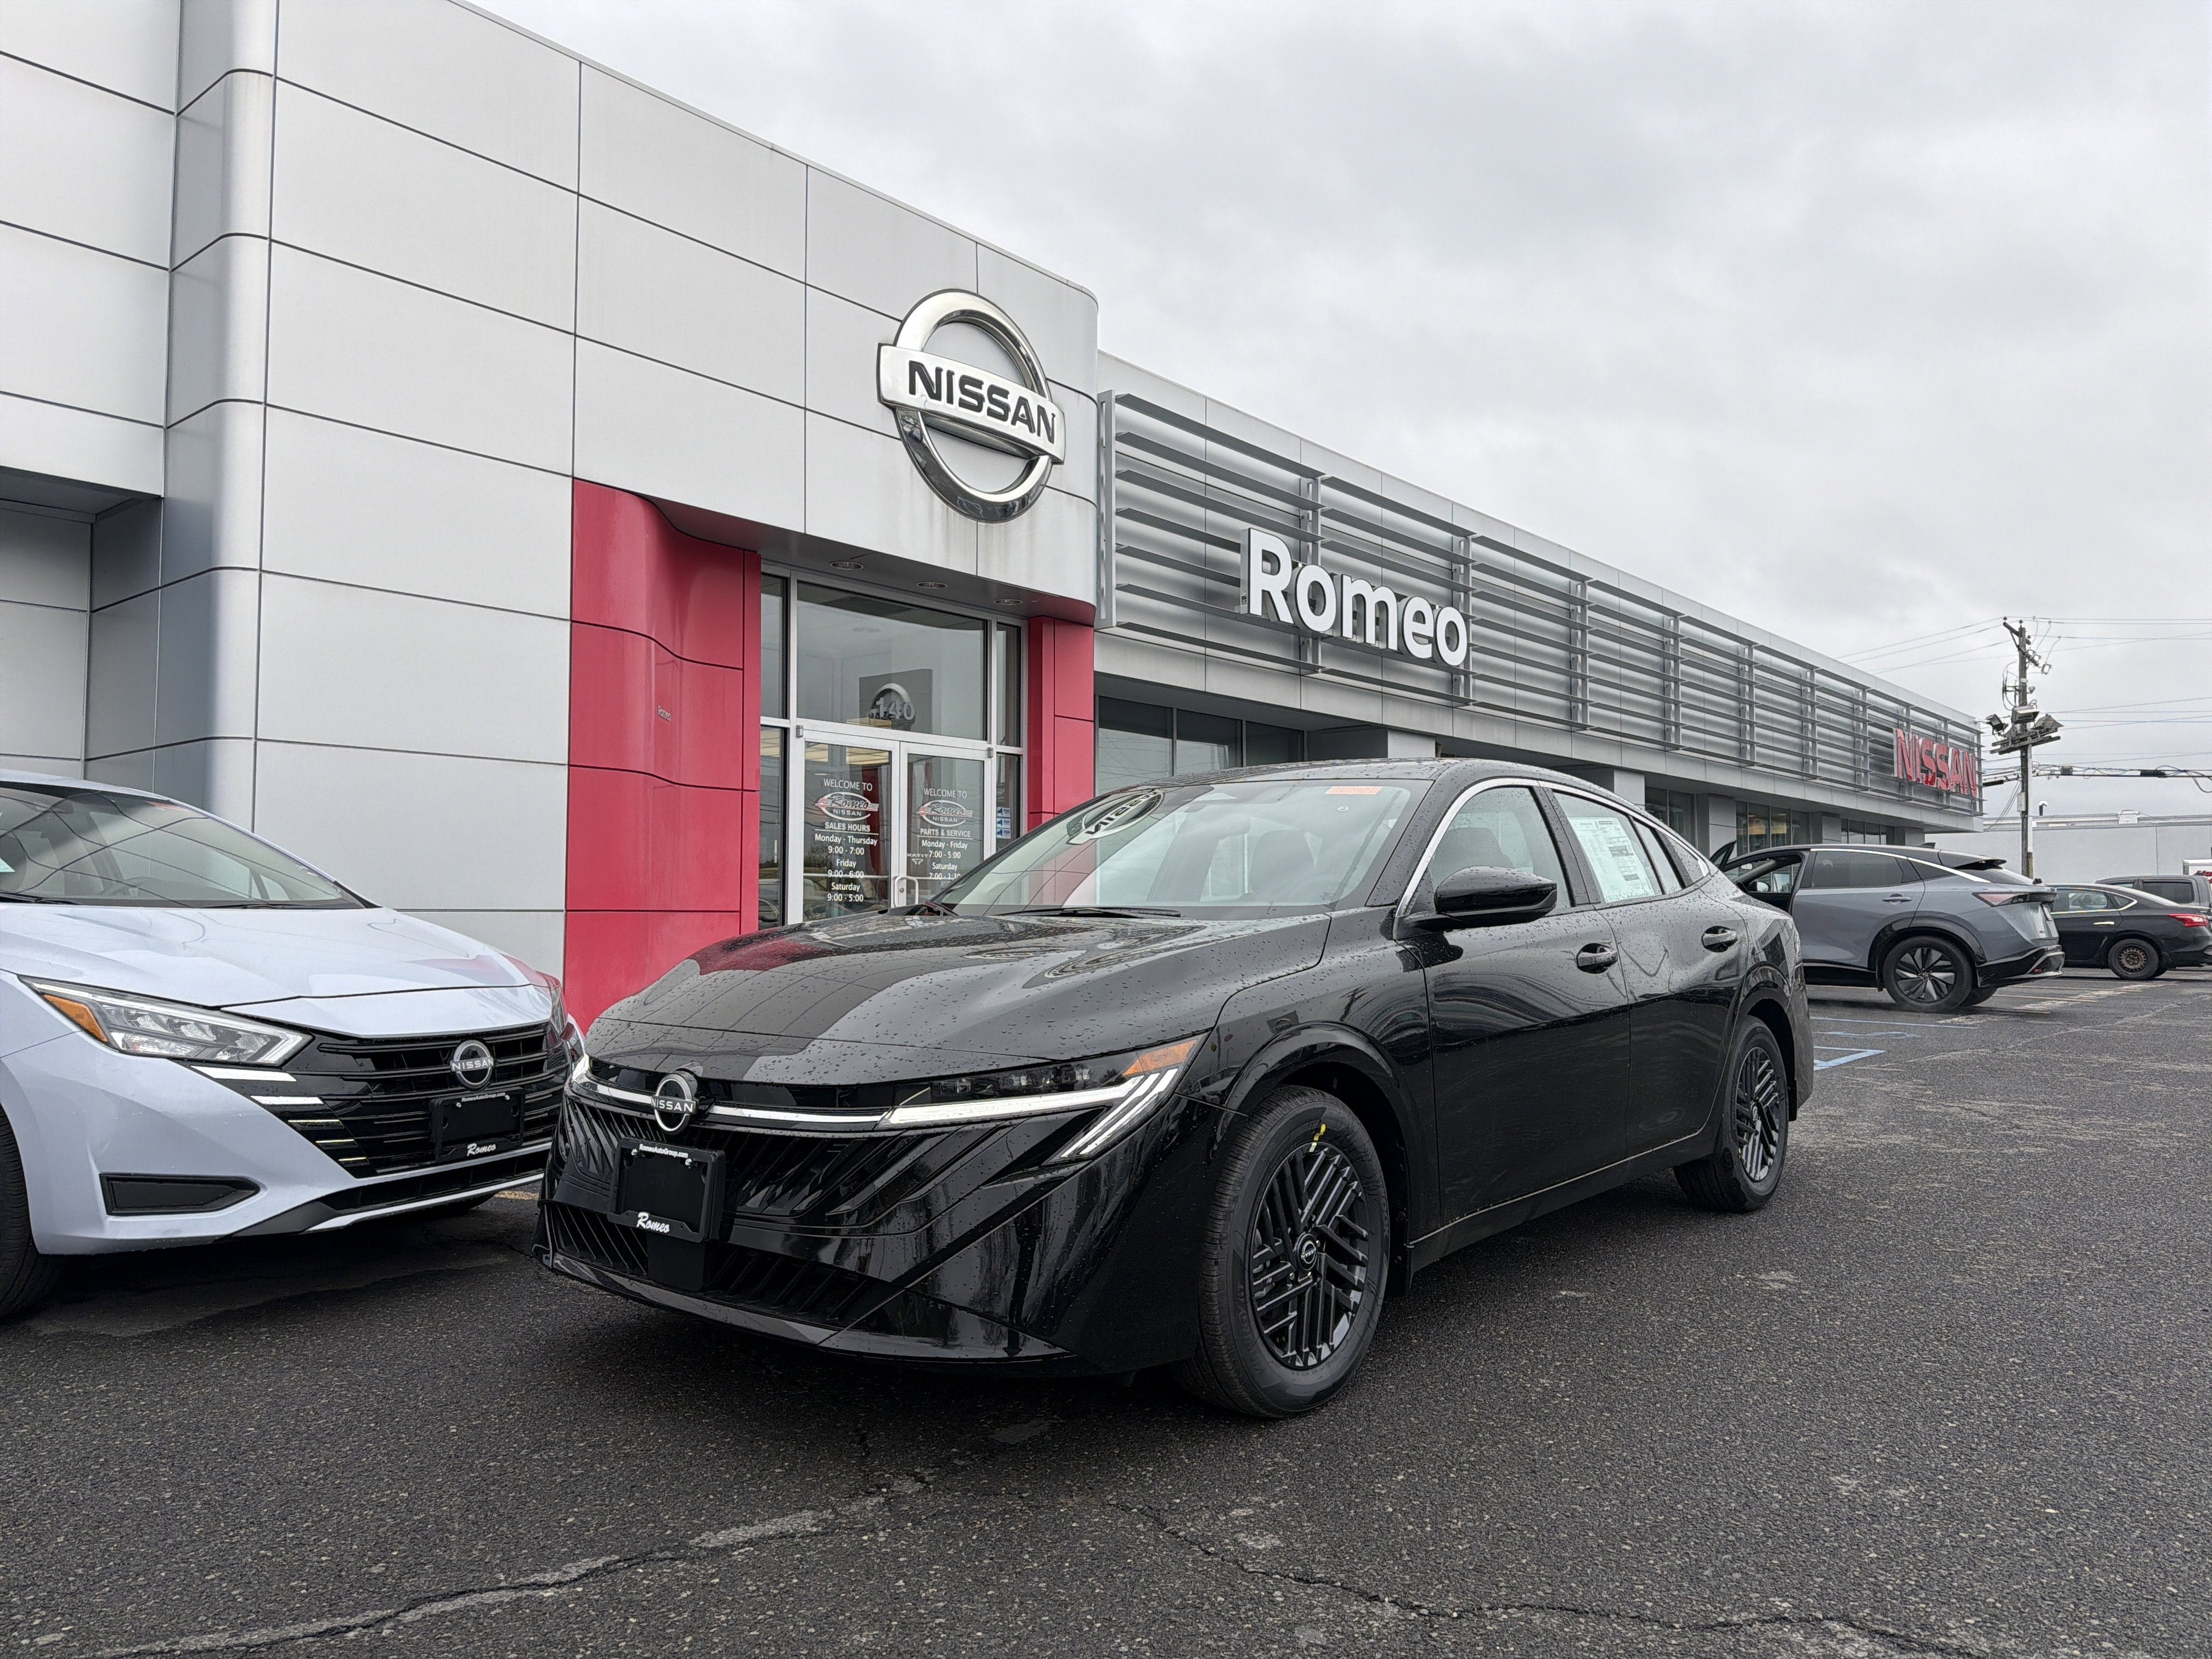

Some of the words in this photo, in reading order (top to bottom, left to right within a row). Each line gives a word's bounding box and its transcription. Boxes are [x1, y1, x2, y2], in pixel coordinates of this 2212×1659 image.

[909, 360, 1056, 445] NISSAN
[1248, 527, 1468, 667] Romeo
[876, 697, 915, 720] 140
[1896, 729, 1977, 798] NISSAN
[823, 778, 860, 790] WELCOME
[862, 782, 873, 791] TO
[923, 788, 956, 798] WELCOME
[957, 791, 967, 799] TO
[827, 793, 870, 809] Romeo
[927, 801, 964, 816] Romeo
[825, 821, 846, 830] SALES
[848, 823, 871, 832] HOURS
[920, 828, 939, 836] PARTS
[815, 833, 842, 844] Monday
[847, 835, 878, 847] Thursday
[922, 839, 945, 849] Monday
[950, 840, 968, 850] Friday
[828, 845, 843, 854] 9:00
[849, 847, 865, 855] 7:00
[929, 850, 943, 858] 7:00
[947, 851, 961, 859] 5:00
[836, 859, 856, 868] Friday
[932, 862, 958, 872] Saturday
[828, 870, 843, 878] 9:00
[849, 871, 864, 879] 6:00
[831, 882, 860, 892] Saturday
[827, 893, 843, 901] 9:00
[849, 894, 864, 902] 5:00
[452, 1058, 494, 1070] NISSAN
[651, 1098, 693, 1113] NISSAN
[466, 1143, 496, 1156] Romeo
[639, 1143, 689, 1159] RomeoAutoGroup.com
[636, 1212, 670, 1233] Romeo
